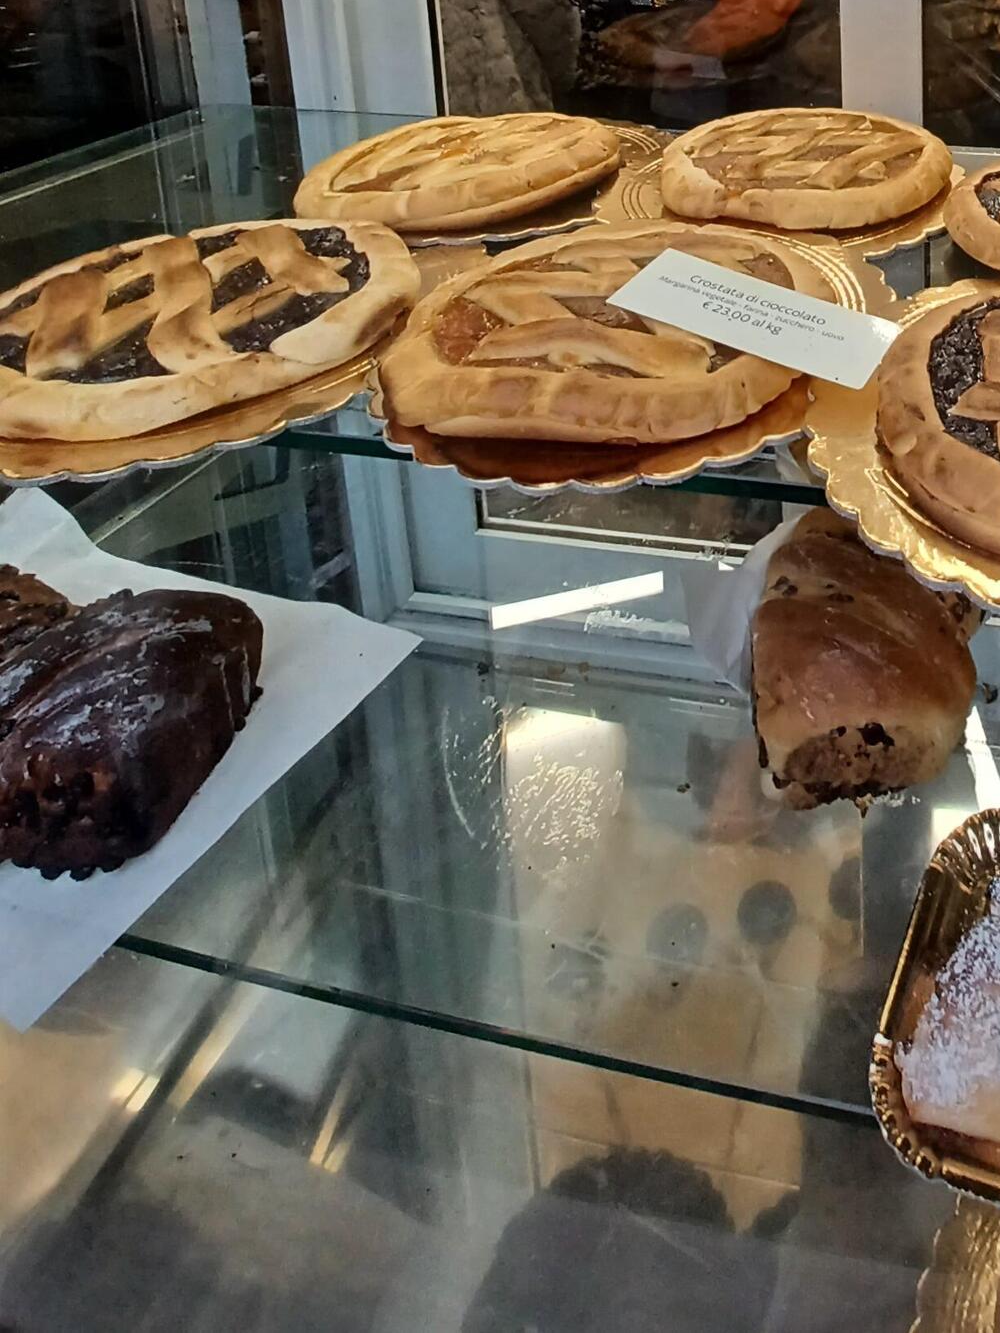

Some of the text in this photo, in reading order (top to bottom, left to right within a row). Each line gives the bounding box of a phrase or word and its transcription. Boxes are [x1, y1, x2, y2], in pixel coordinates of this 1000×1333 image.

[658, 276, 700, 294] Margarina
[702, 291, 737, 306] vegetale
[743, 305, 769, 317] farina
[775, 315, 815, 332] zucchero
[690, 275, 826, 325] Crostata di cioccolato
[751, 319, 766, 327] al
[765, 322, 782, 335] kg
